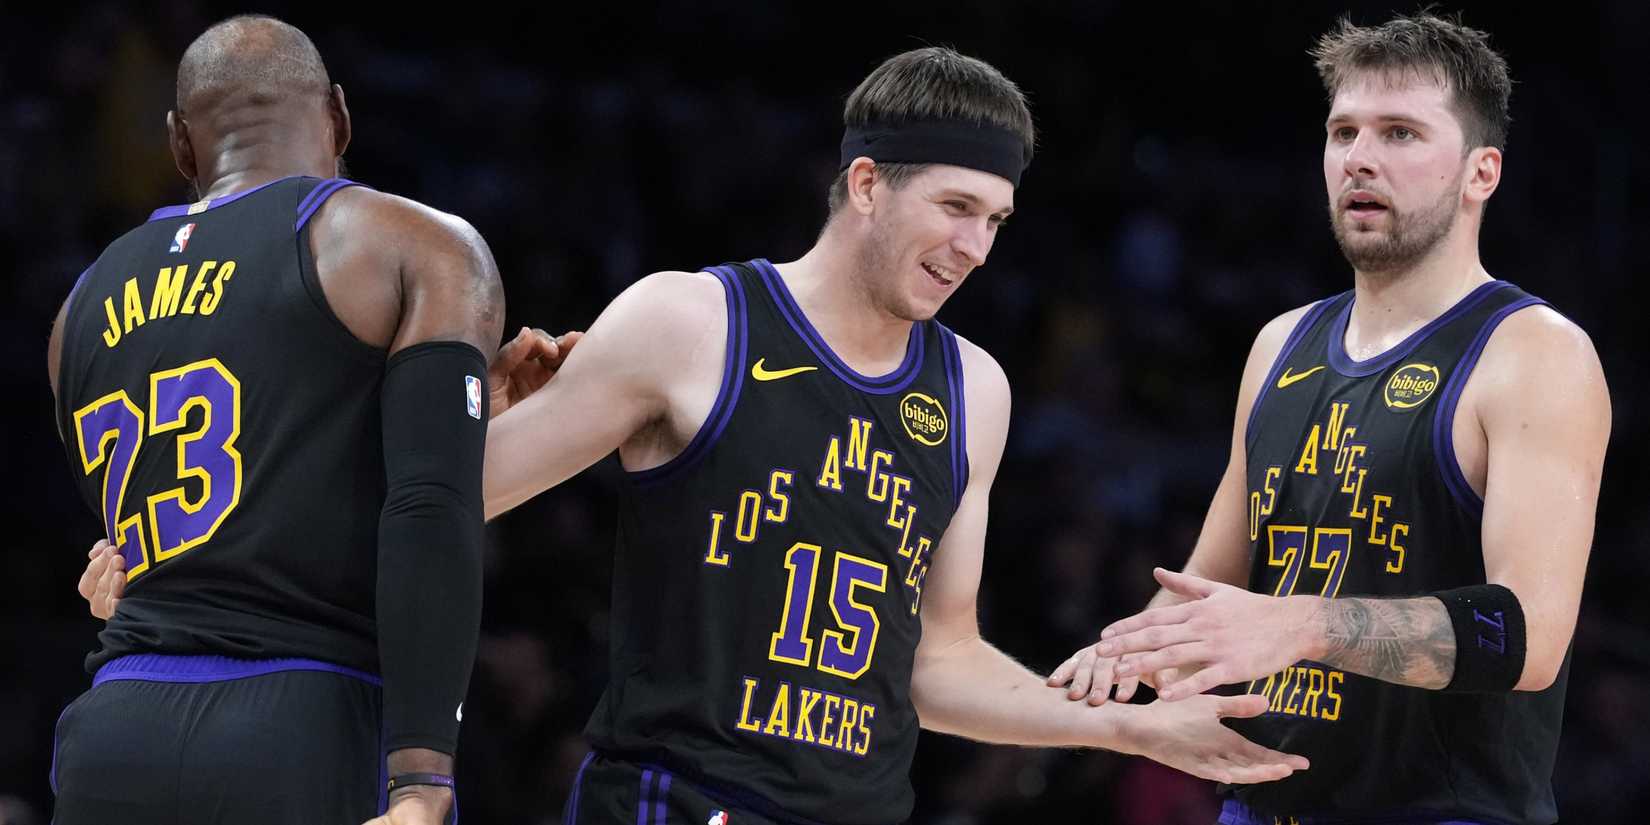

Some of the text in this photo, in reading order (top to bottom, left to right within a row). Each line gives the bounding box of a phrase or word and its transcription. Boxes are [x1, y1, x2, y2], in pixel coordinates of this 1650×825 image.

[103, 261, 236, 347] JAMES
[904, 402, 946, 433] bibigo
[1391, 374, 1434, 396] bibigo
[73, 358, 242, 582] 23
[1250, 402, 1409, 574] OS ANGELES
[705, 417, 932, 616] LOS ANGELES
[1267, 524, 1353, 599] 77
[769, 543, 888, 679] 15
[736, 679, 875, 756] LAKERS
[1248, 666, 1345, 722] AKERS
